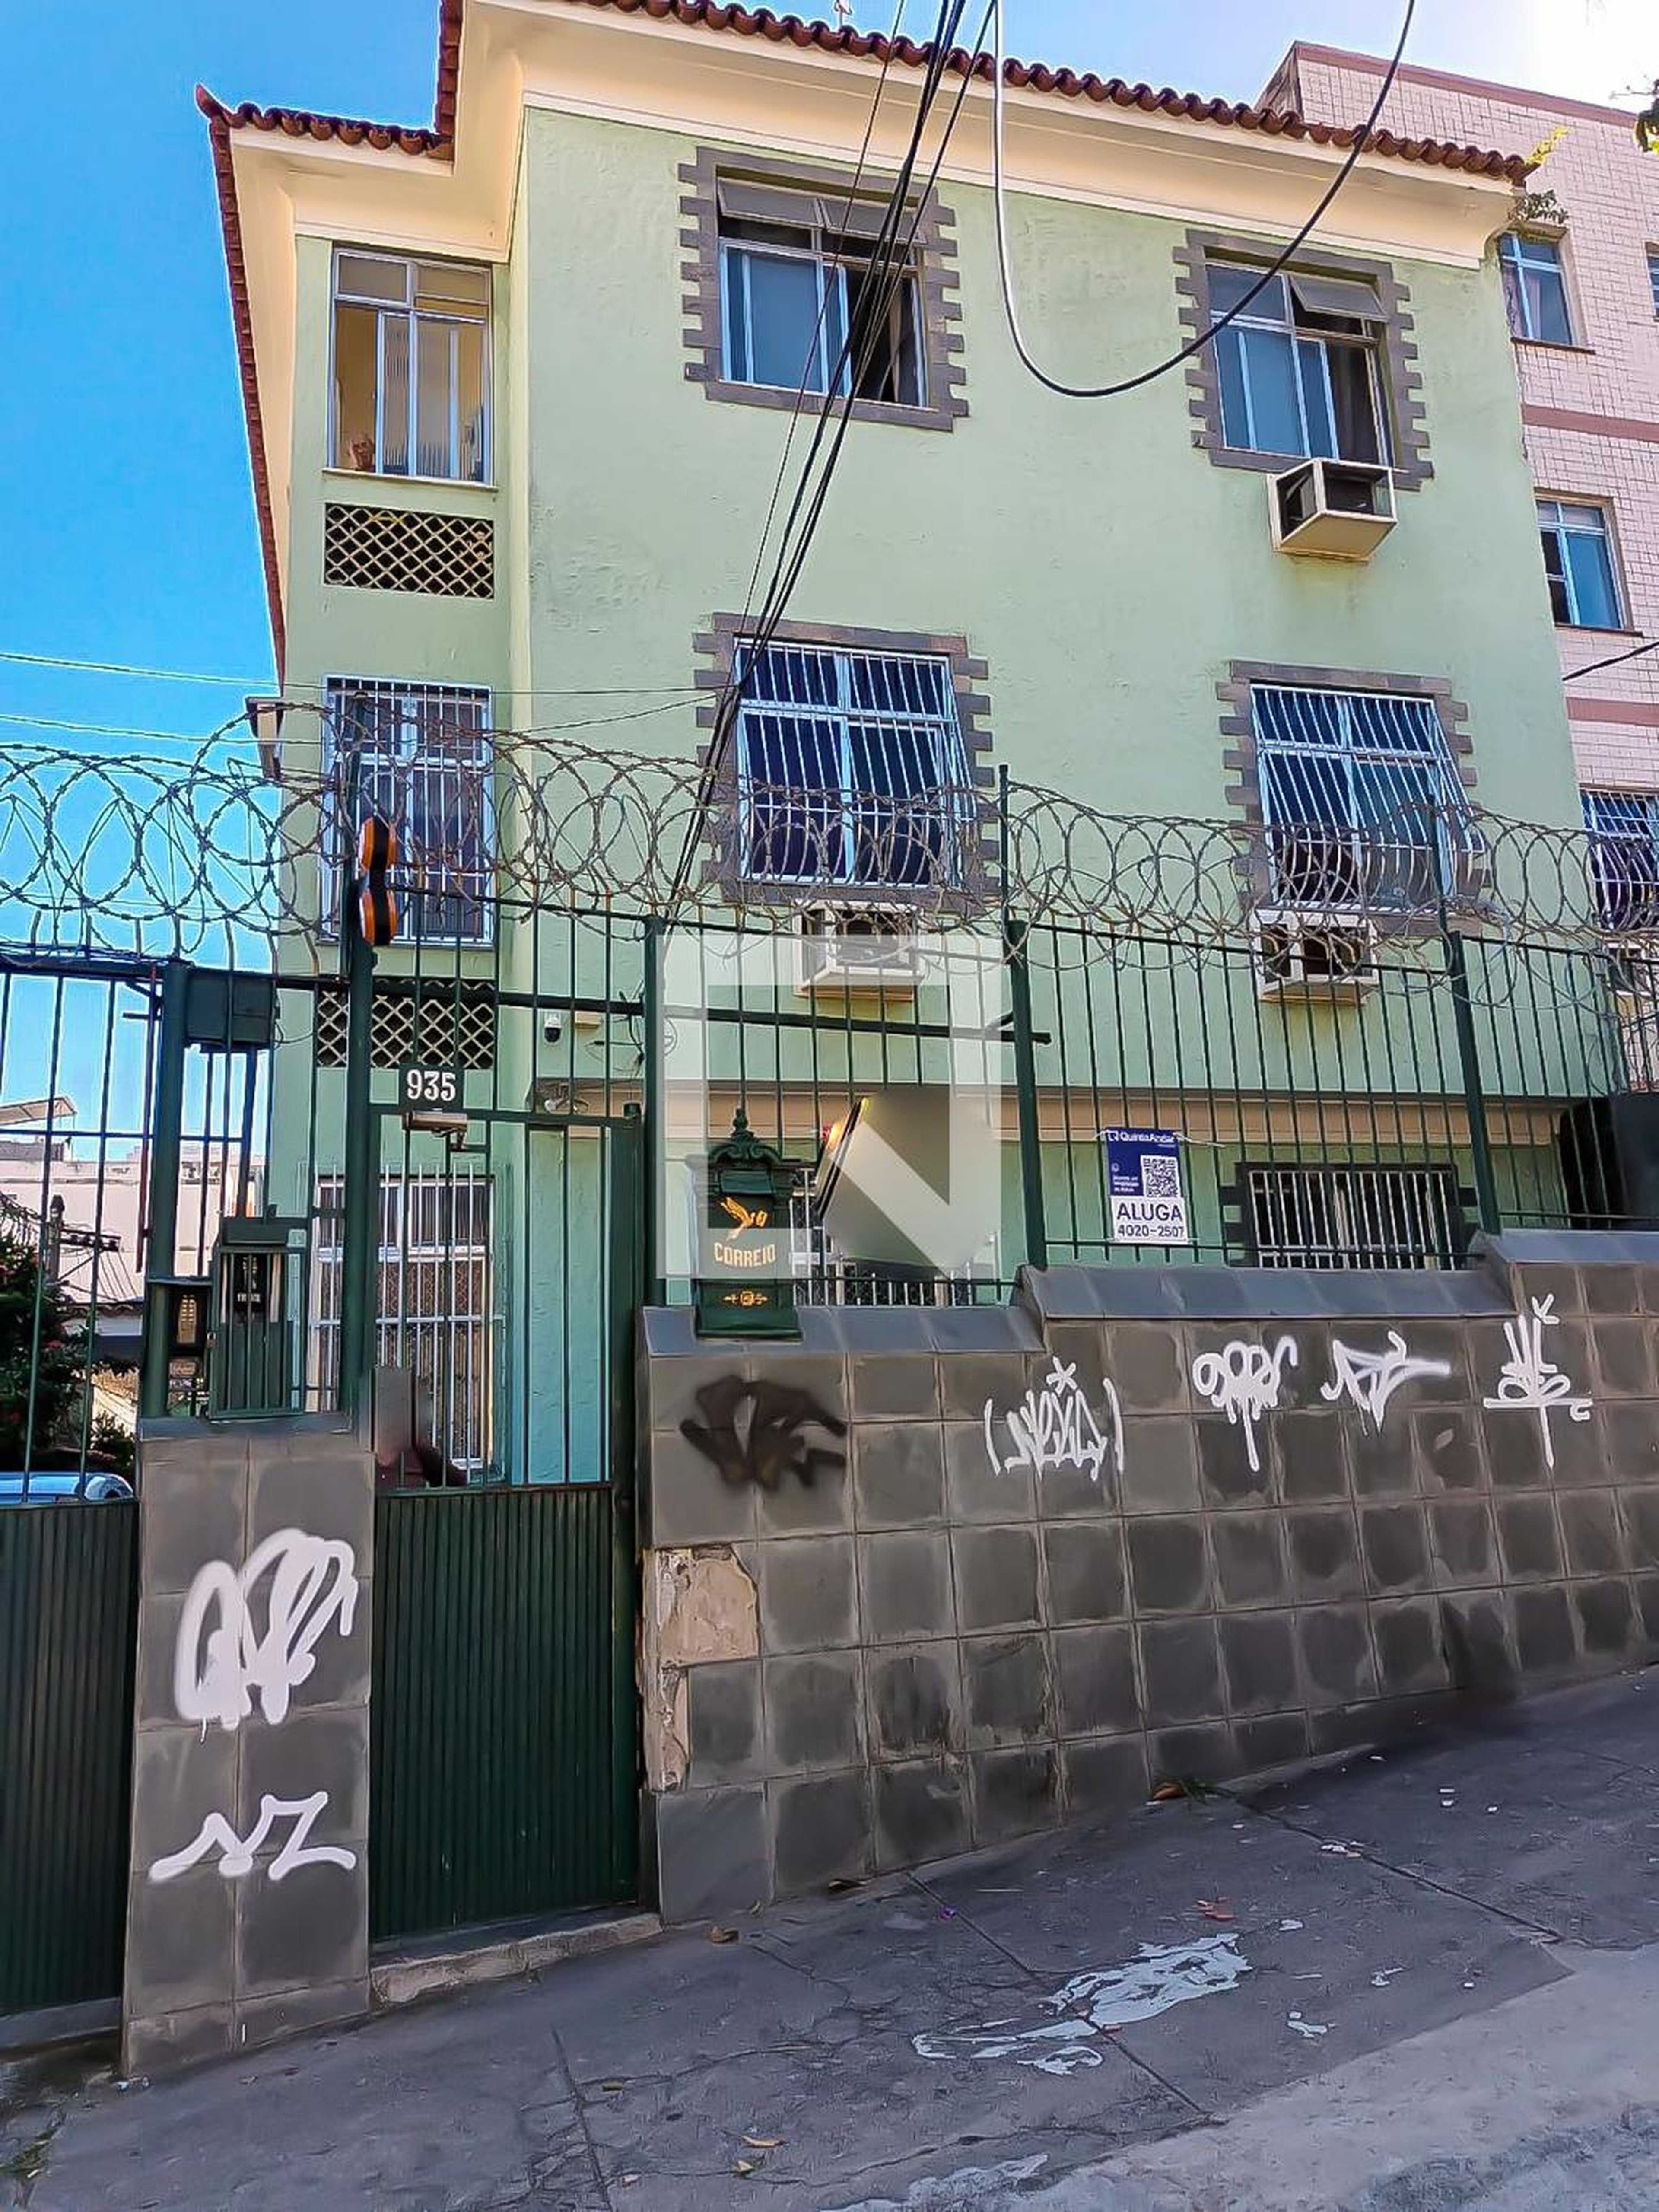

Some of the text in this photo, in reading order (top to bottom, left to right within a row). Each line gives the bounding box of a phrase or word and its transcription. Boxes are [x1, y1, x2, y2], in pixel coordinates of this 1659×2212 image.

[407, 1069, 456, 1101] 935
[1117, 1203, 1183, 1221] ALUGA
[1118, 1225, 1184, 1238] 4020-2507
[714, 1242, 776, 1268] CORREIO
